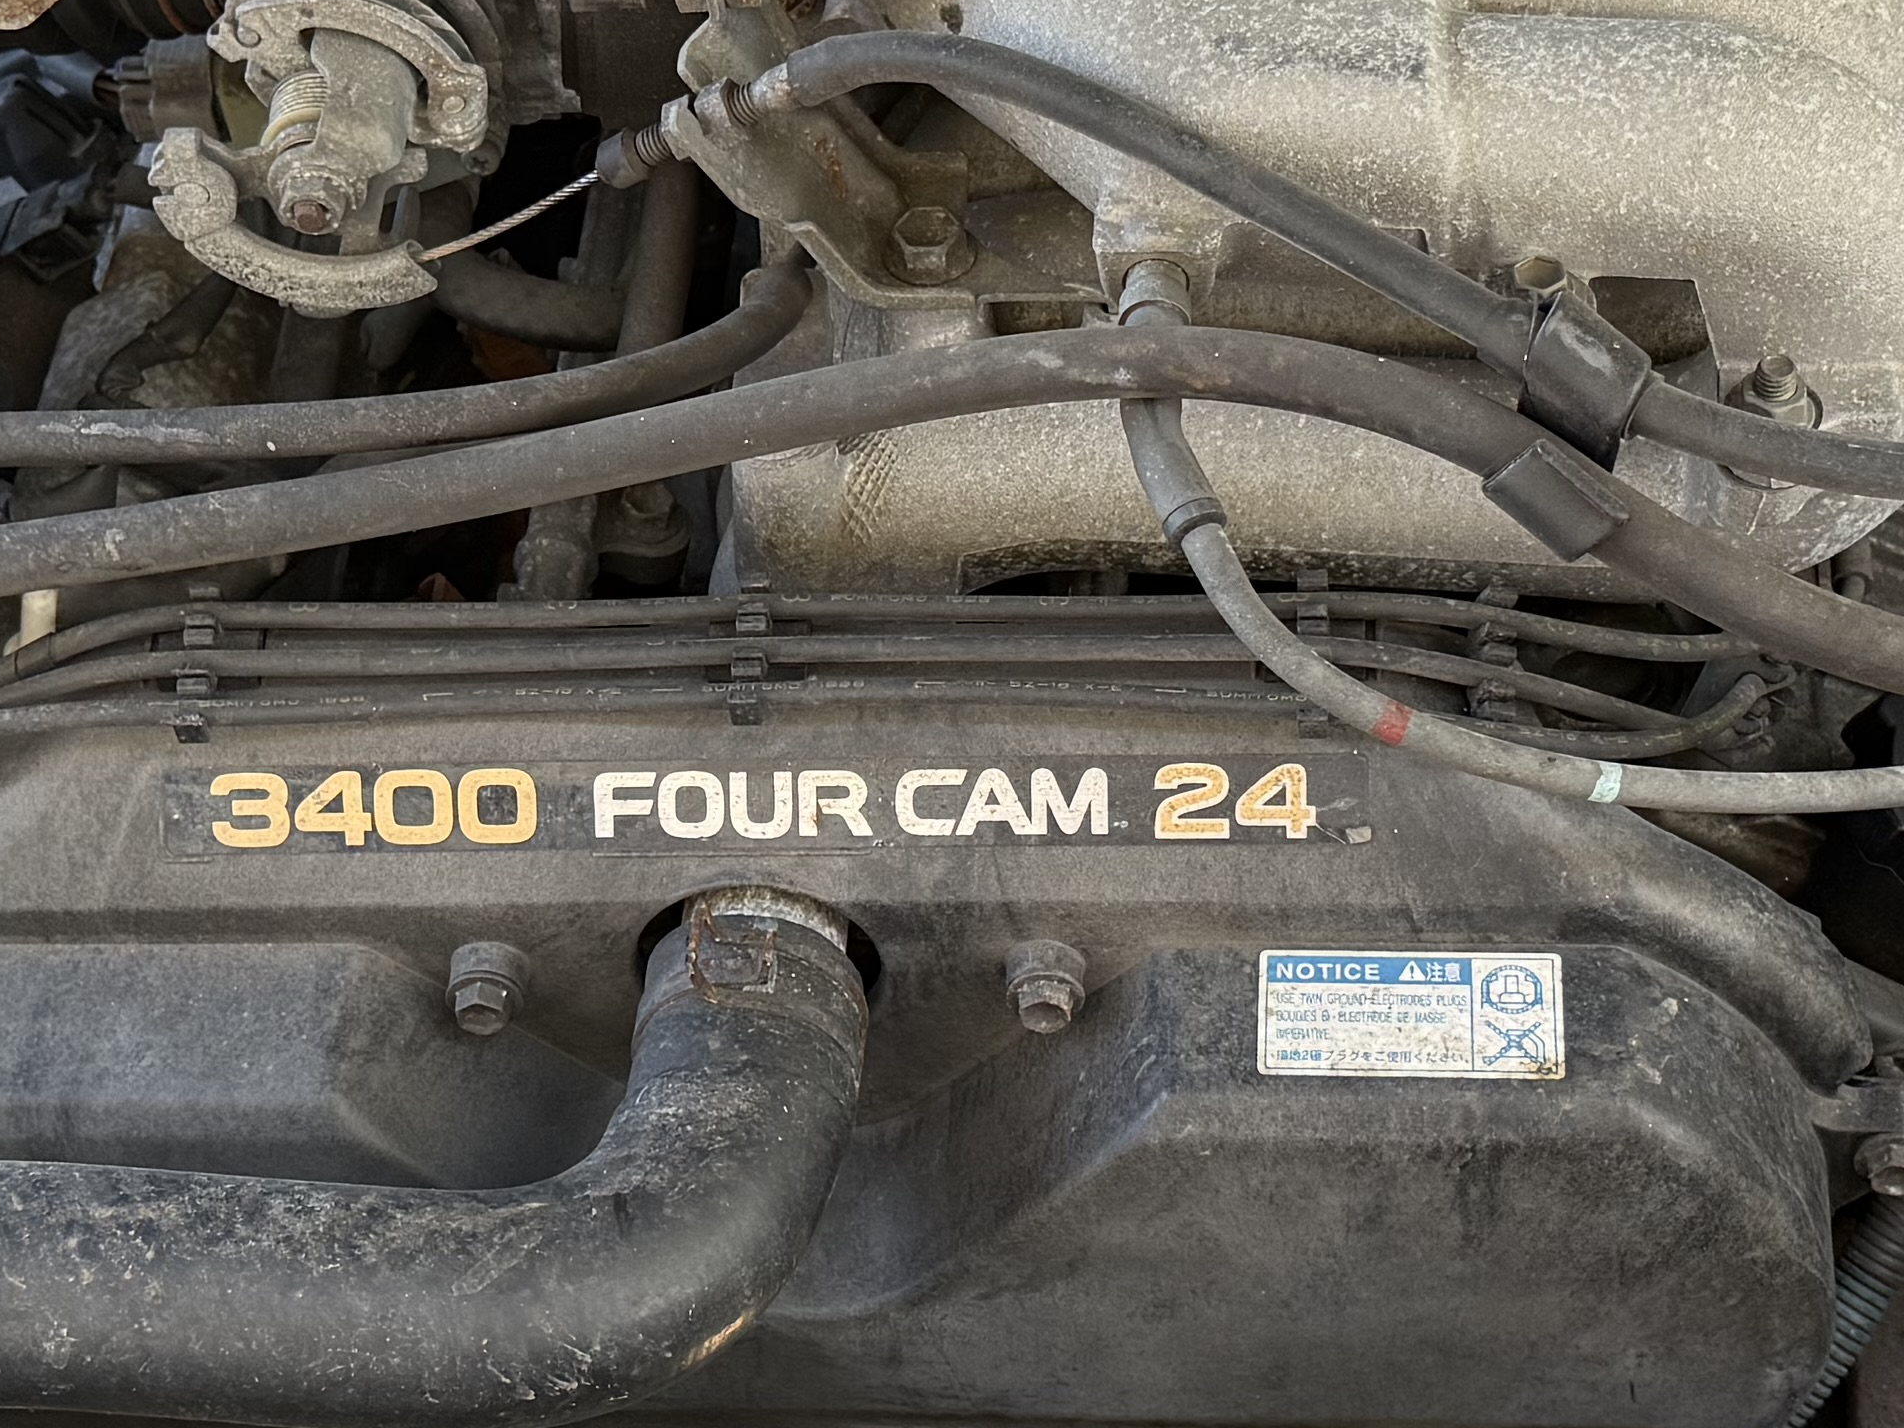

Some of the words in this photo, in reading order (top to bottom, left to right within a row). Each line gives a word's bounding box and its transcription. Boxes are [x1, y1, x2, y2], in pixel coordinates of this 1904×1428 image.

[209, 768, 538, 848] 3400
[592, 767, 871, 843] FOUR
[895, 766, 1110, 838] CAM
[1152, 761, 1318, 841] 24
[1276, 961, 1381, 982] NOTICE
[1426, 961, 1462, 983] 注意
[1276, 993, 1295, 1005] USE
